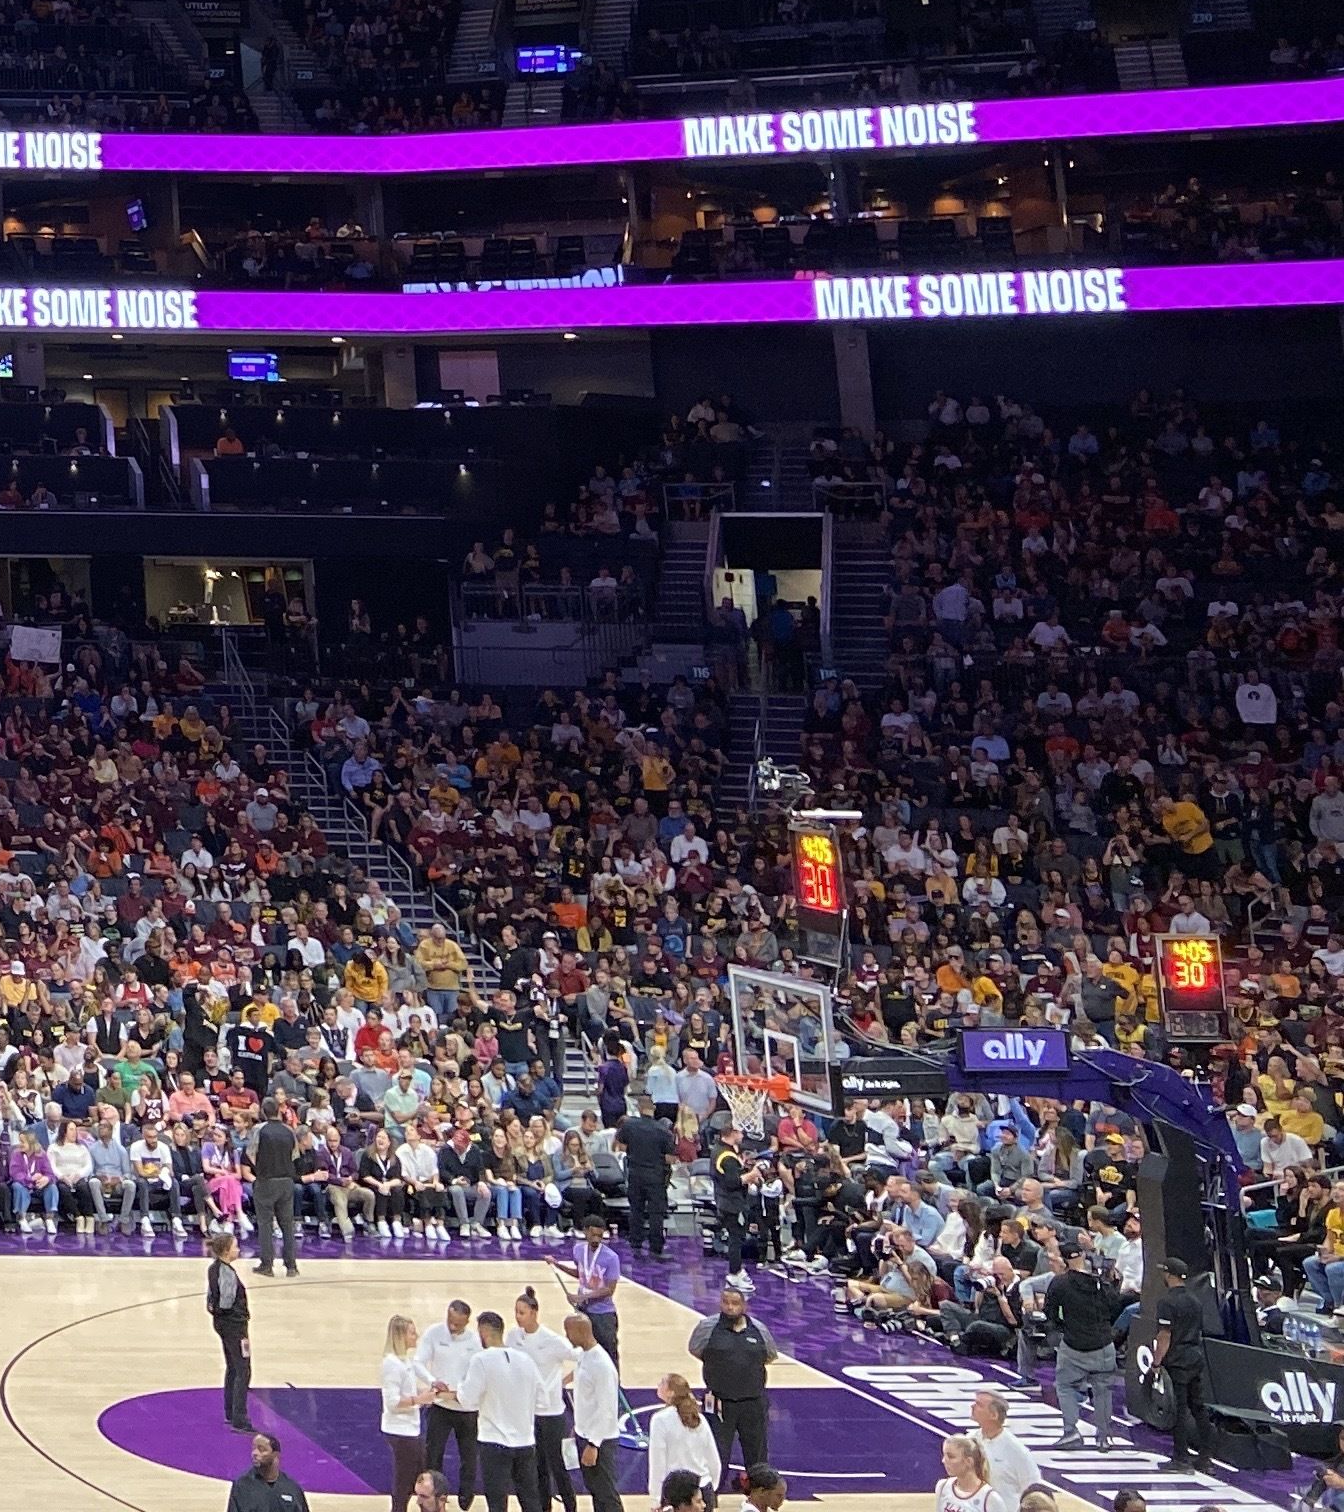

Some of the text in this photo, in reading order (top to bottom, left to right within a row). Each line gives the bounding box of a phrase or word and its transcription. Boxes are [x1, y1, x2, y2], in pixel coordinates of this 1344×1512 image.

[185, 1, 220, 10] UTILITY
[684, 101, 978, 157] MAKE SOME NOISE
[25, 131, 103, 171] NOISE
[33, 288, 113, 328] SOME
[117, 289, 199, 330] NOISE
[814, 267, 1127, 322] MAKE SOME NOISE
[692, 667, 711, 680] 116
[801, 859, 833, 907] 30
[1175, 961, 1206, 988] 30
[982, 1032, 1046, 1067] ally
[842, 1075, 864, 1091] ally
[1260, 1370, 1336, 1423] ally
